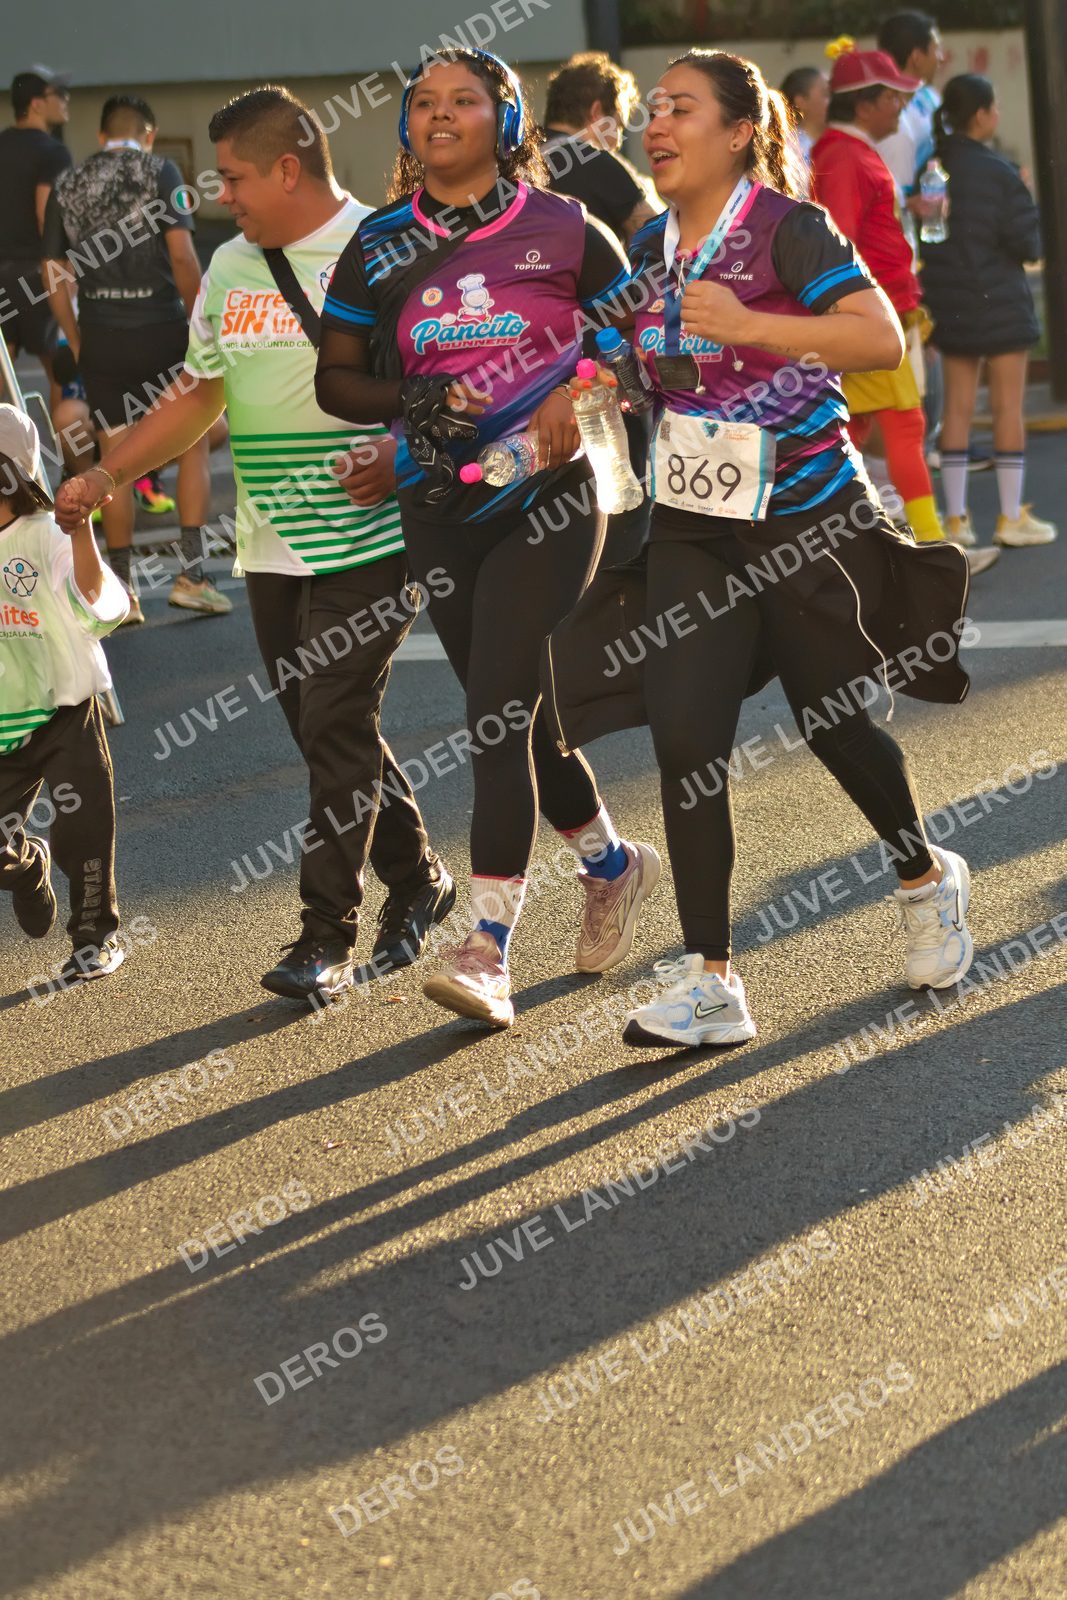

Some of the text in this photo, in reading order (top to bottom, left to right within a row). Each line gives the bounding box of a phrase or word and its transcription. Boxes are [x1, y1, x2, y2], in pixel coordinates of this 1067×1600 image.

[719, 273, 753, 281] TOPTIME
[221, 310, 269, 337] SIN
[411, 311, 530, 355] Pancito
[438, 337, 520, 351] RUNNERS
[667, 453, 742, 502] 869
